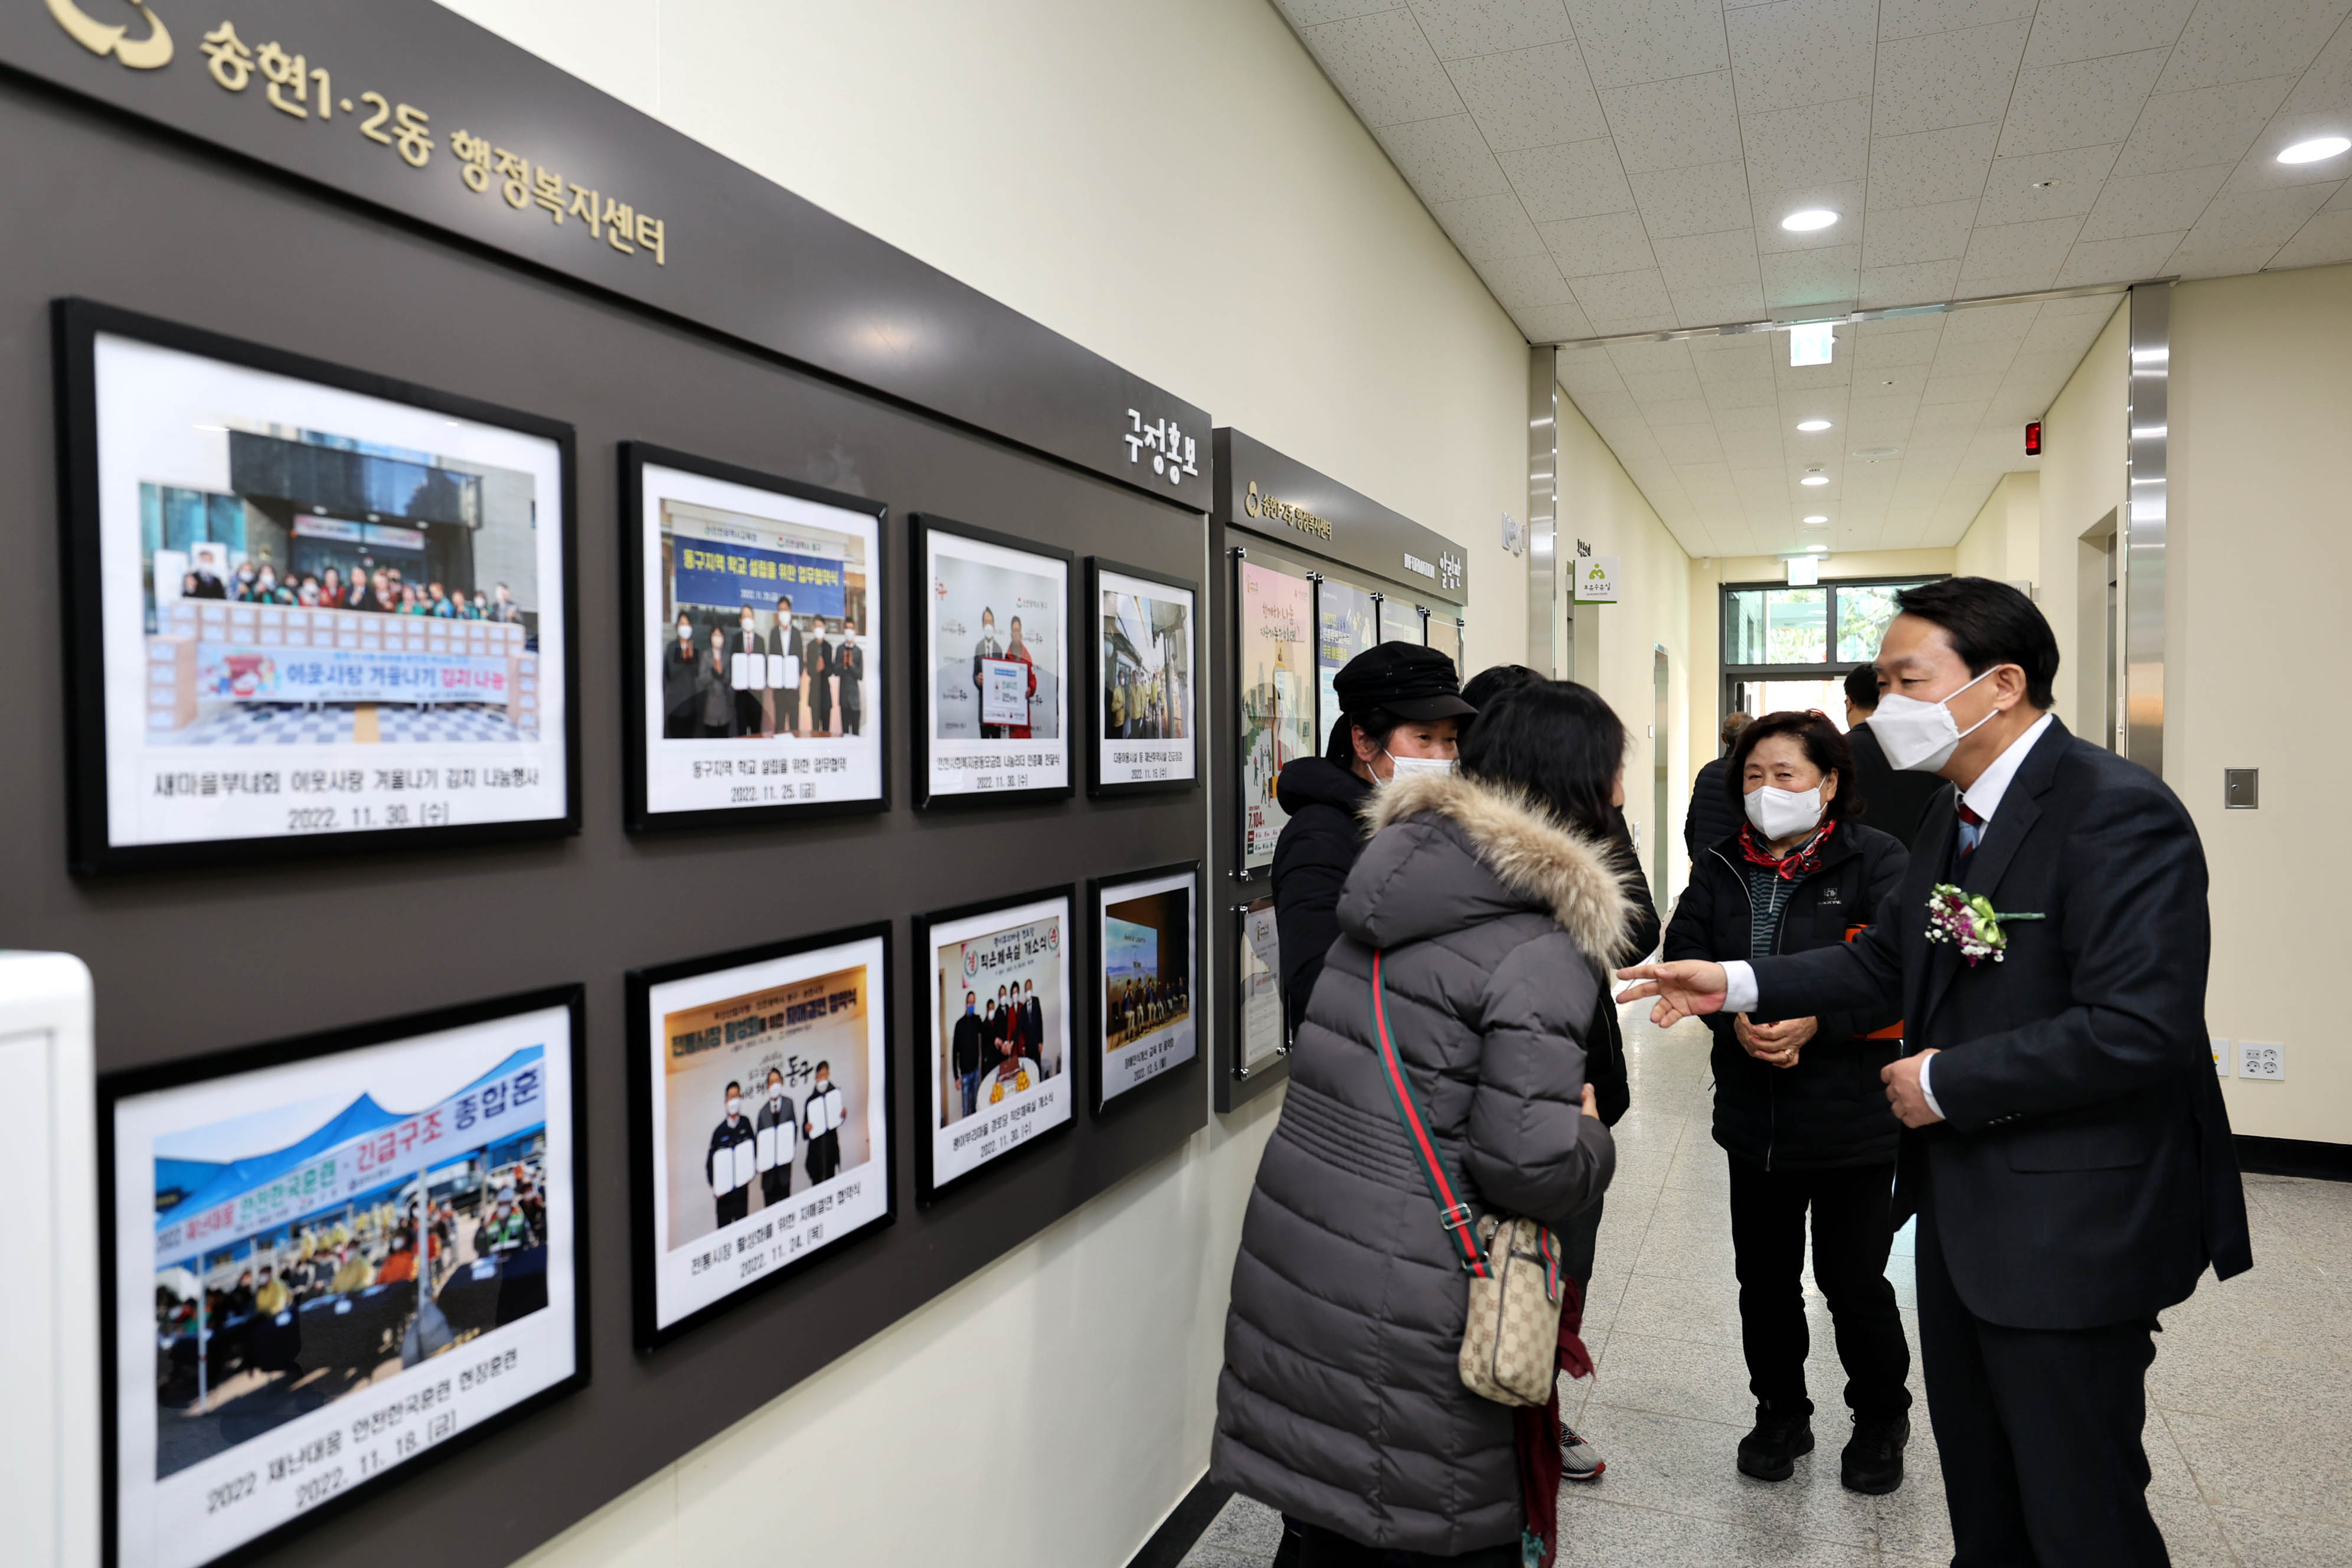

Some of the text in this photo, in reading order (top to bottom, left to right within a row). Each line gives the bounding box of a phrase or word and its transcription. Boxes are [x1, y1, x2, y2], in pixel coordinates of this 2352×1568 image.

[199, 20, 665, 265] 송현1·2동 행정복지센터
[1125, 409, 1198, 485] 구정홍보
[1261, 494, 1332, 540] 송현1·2동 행정복지센터
[683, 548, 839, 587] 동구지역 학교 설립을 위한 업무협약식
[1404, 553, 1435, 579] INFORMATION
[1439, 551, 1461, 589] 알림판
[1584, 582, 1611, 590] 모유수유실
[153, 767, 540, 798] 새마을부녀회 이웃사랑 겨울나기 김치 나눔행사
[693, 759, 733, 779] 동구지역
[737, 760, 756, 775] 학교
[793, 757, 810, 773] 위한
[814, 757, 847, 773] 업무협약
[976, 776, 993, 790] 2022.
[731, 786, 758, 802] 2022.
[764, 785, 778, 799] 11.
[782, 784, 796, 799] 25.
[288, 801, 450, 831] 2022. 11. 30. (수)
[981, 943, 1021, 970] 작은체육실
[1025, 936, 1047, 956] 개소식
[785, 1054, 814, 1088] 동구
[186, 1202, 236, 1240] 재난대응
[357, 1109, 443, 1172] 긴급구조
[455, 1068, 539, 1131] 종합훈
[691, 1241, 733, 1276] 전통시장
[778, 1211, 796, 1233] 위한
[740, 1252, 766, 1279] 2022.
[772, 1244, 786, 1262] 11.
[207, 1347, 518, 1515] 2022 재난대응 안전한국훈련 현장훈련
[296, 1409, 457, 1510] 2022. 11. 18. (금)
